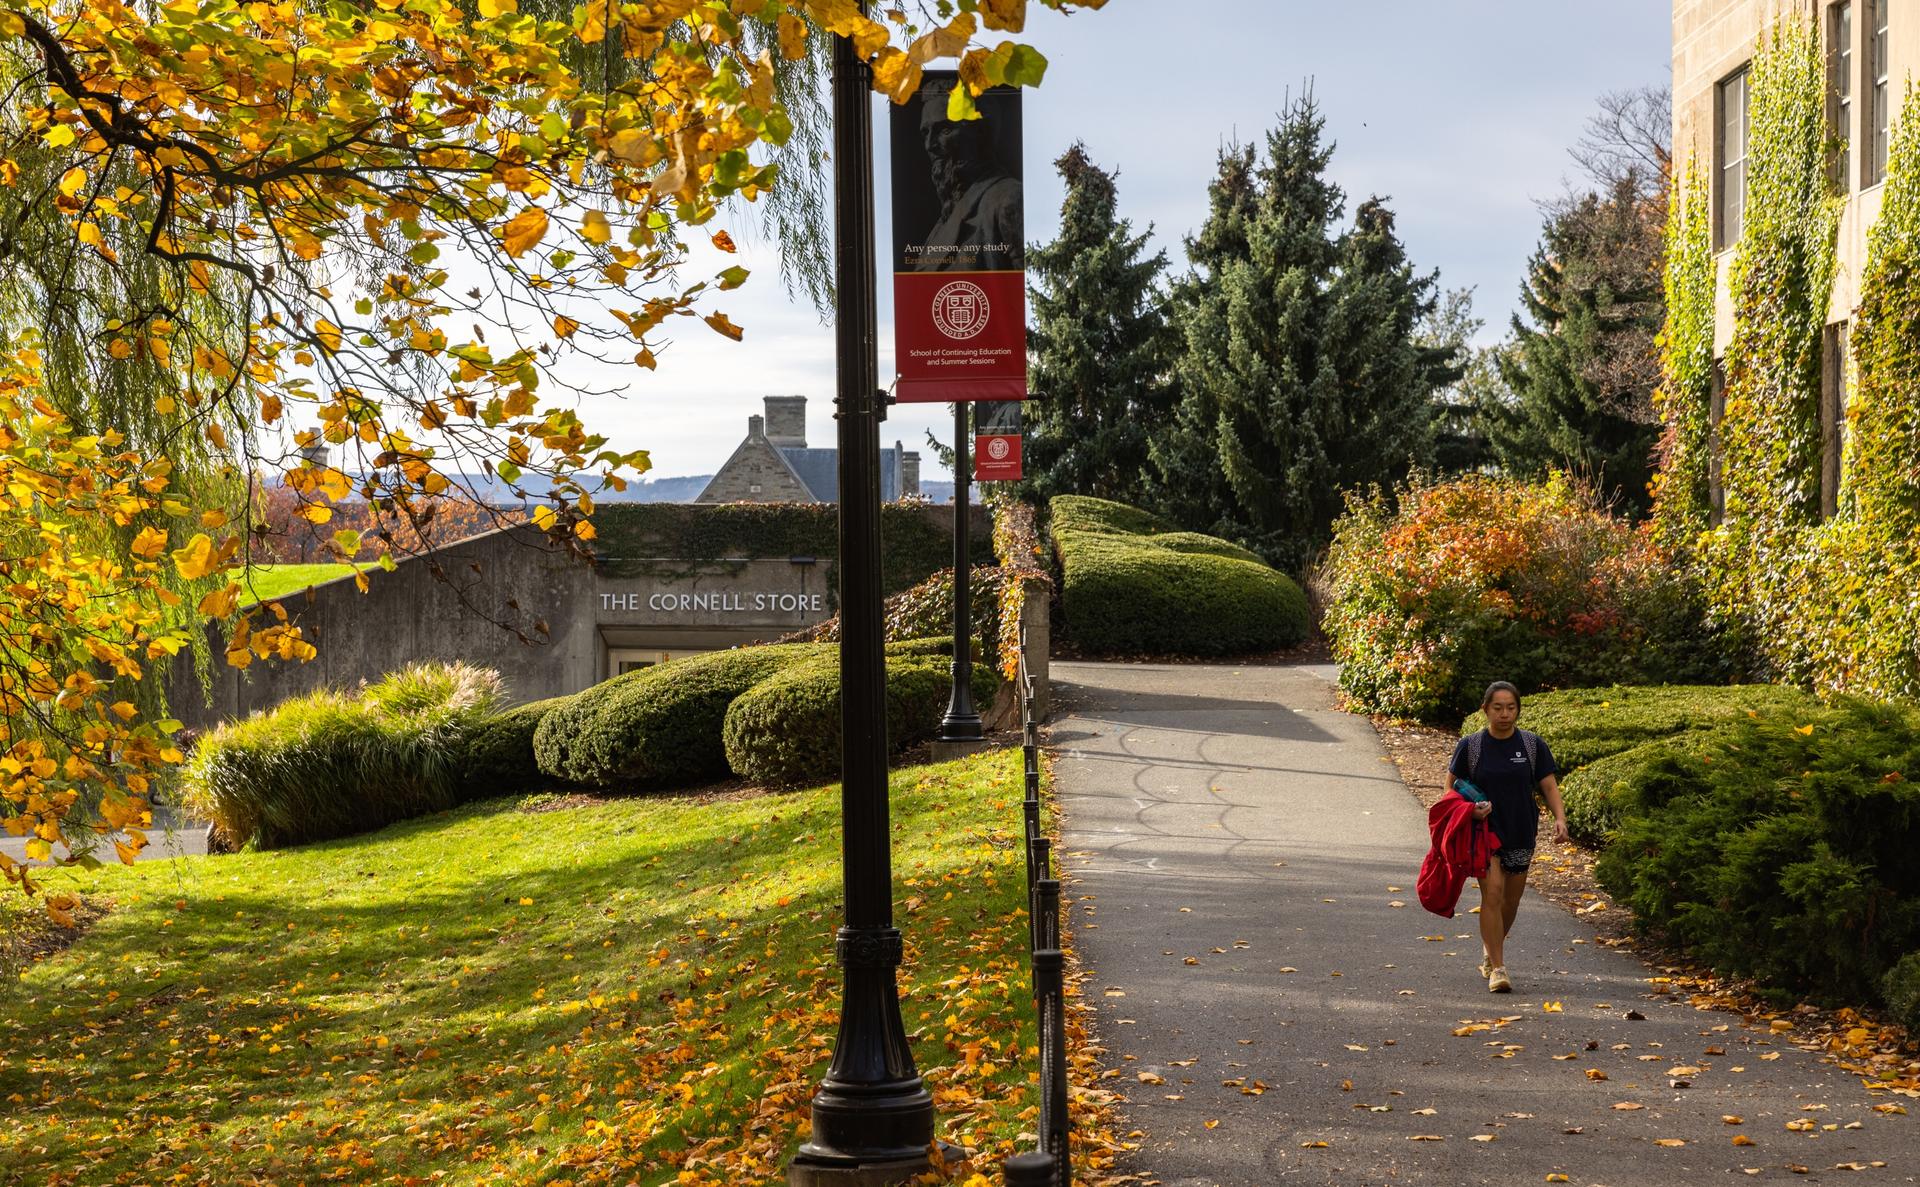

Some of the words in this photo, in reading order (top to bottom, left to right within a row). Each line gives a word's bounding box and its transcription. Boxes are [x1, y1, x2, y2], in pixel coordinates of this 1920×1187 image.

[904, 243, 925, 255] Any
[927, 244, 961, 255] person,
[963, 244, 981, 255] any
[983, 242, 1010, 254] study
[934, 284, 954, 312] CORNELL
[956, 283, 988, 311] UNIVERSITY
[935, 315, 962, 338] FOUNDED
[910, 349, 932, 357] School
[932, 349, 941, 357] of
[941, 348, 978, 357] Continuing
[979, 347, 1012, 356] Education
[926, 358, 940, 366] and
[940, 358, 968, 366] Summer
[969, 357, 996, 365] Sessions
[600, 593, 639, 611] THE
[649, 593, 745, 611] CORNELL
[755, 593, 822, 612] STORE
